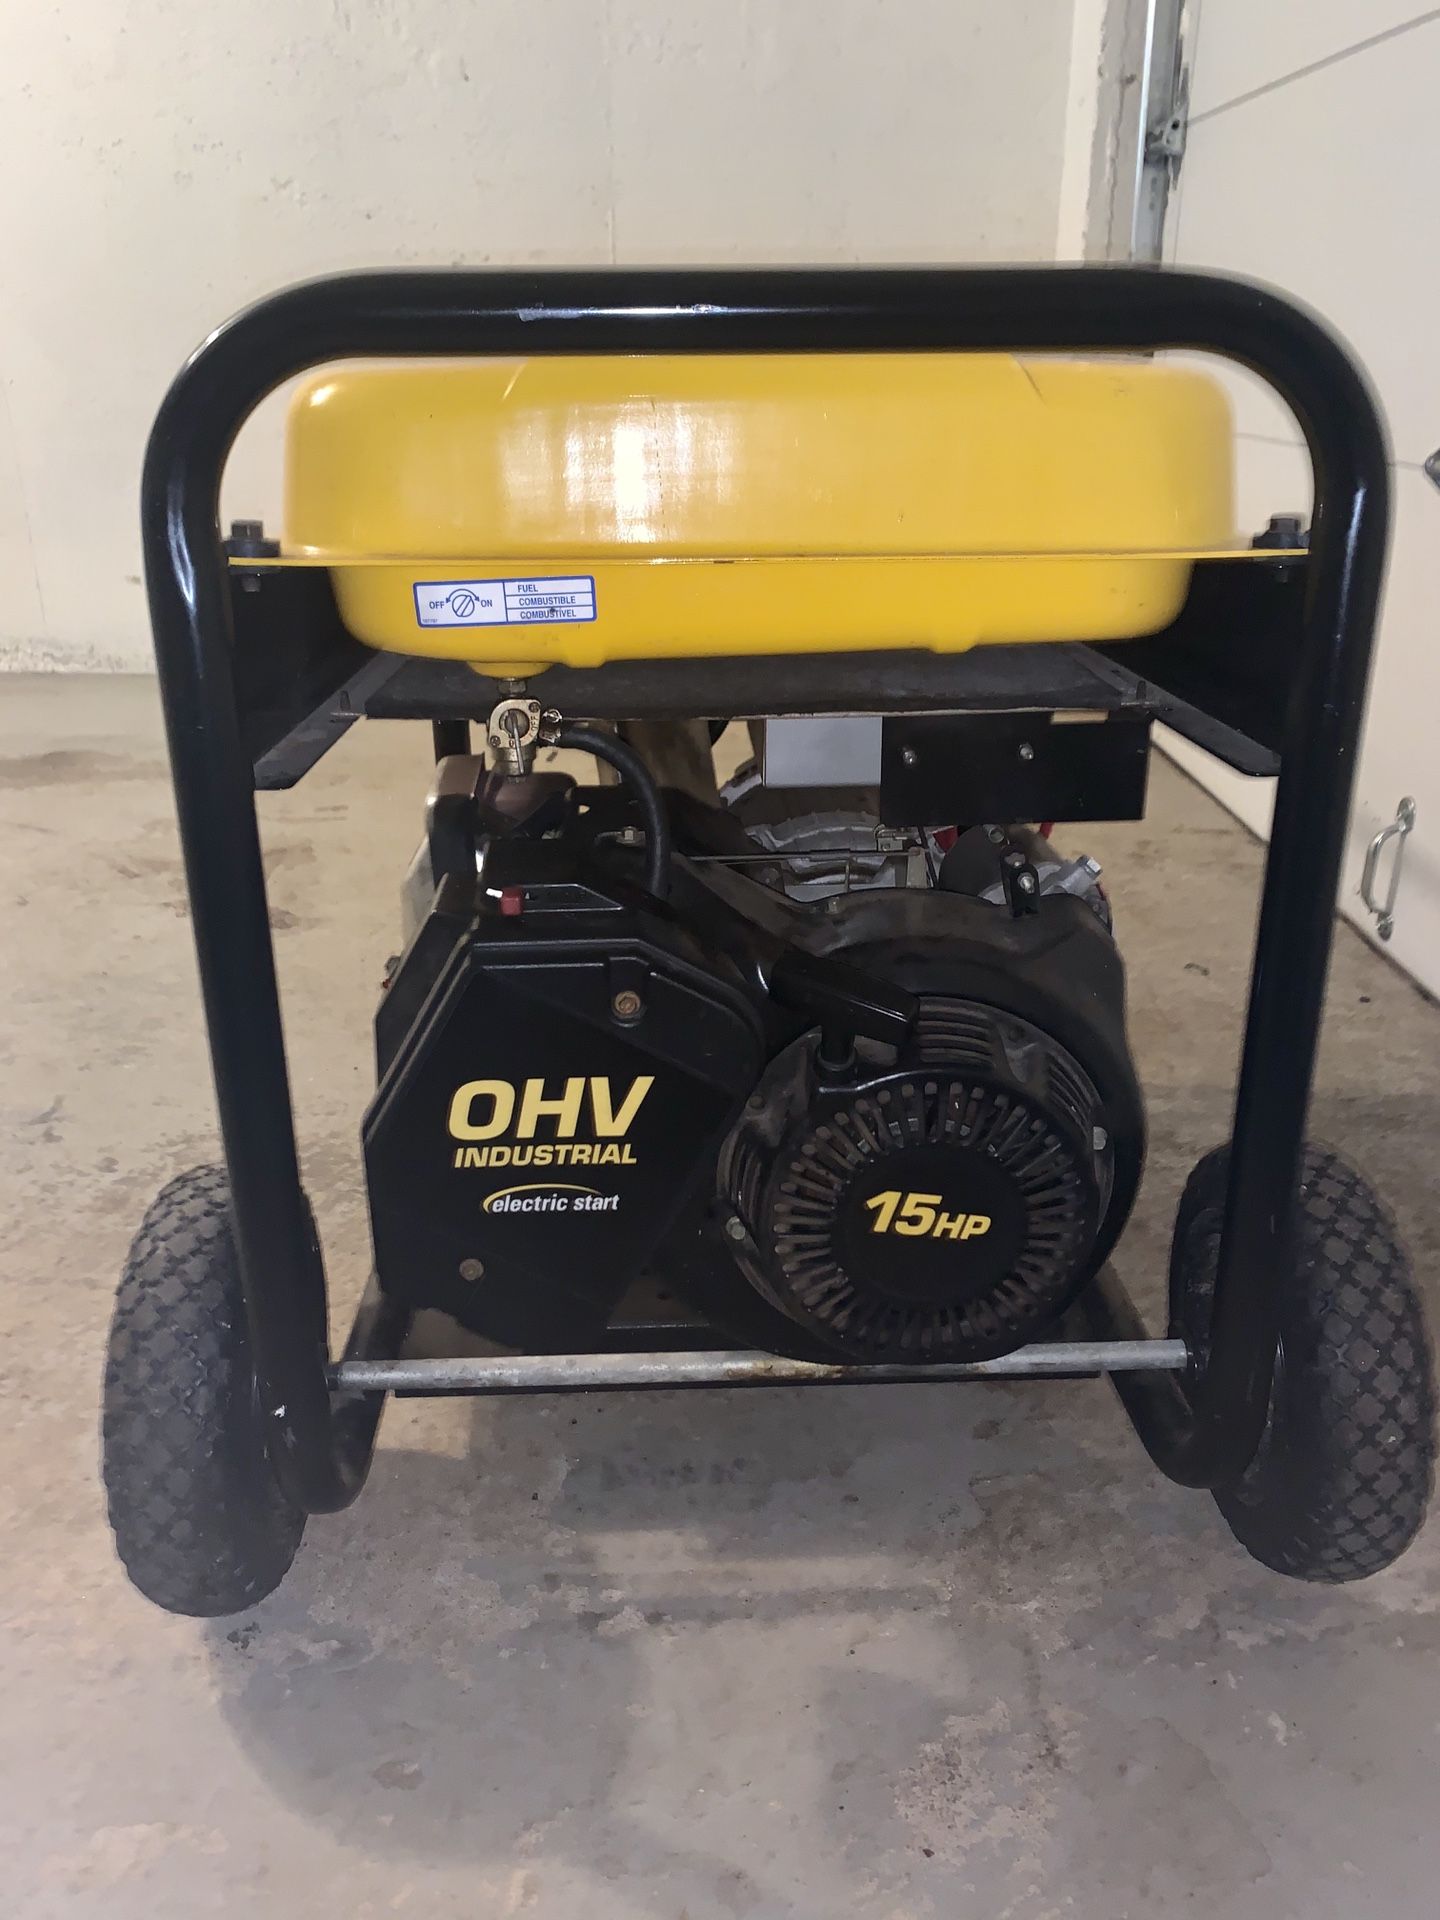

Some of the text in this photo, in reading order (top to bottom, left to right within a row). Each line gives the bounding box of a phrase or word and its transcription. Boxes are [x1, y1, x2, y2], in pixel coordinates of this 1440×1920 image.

[517, 584, 539, 593] FUEL
[429, 601, 445, 609] OFF
[480, 599, 493, 608] ON
[519, 595, 577, 606] COMBUSTIBLE
[447, 1075, 656, 1141] OHV
[454, 1143, 638, 1168] INDUSTRIAL
[491, 1193, 621, 1213] electric start
[866, 1190, 992, 1240] 15HP
